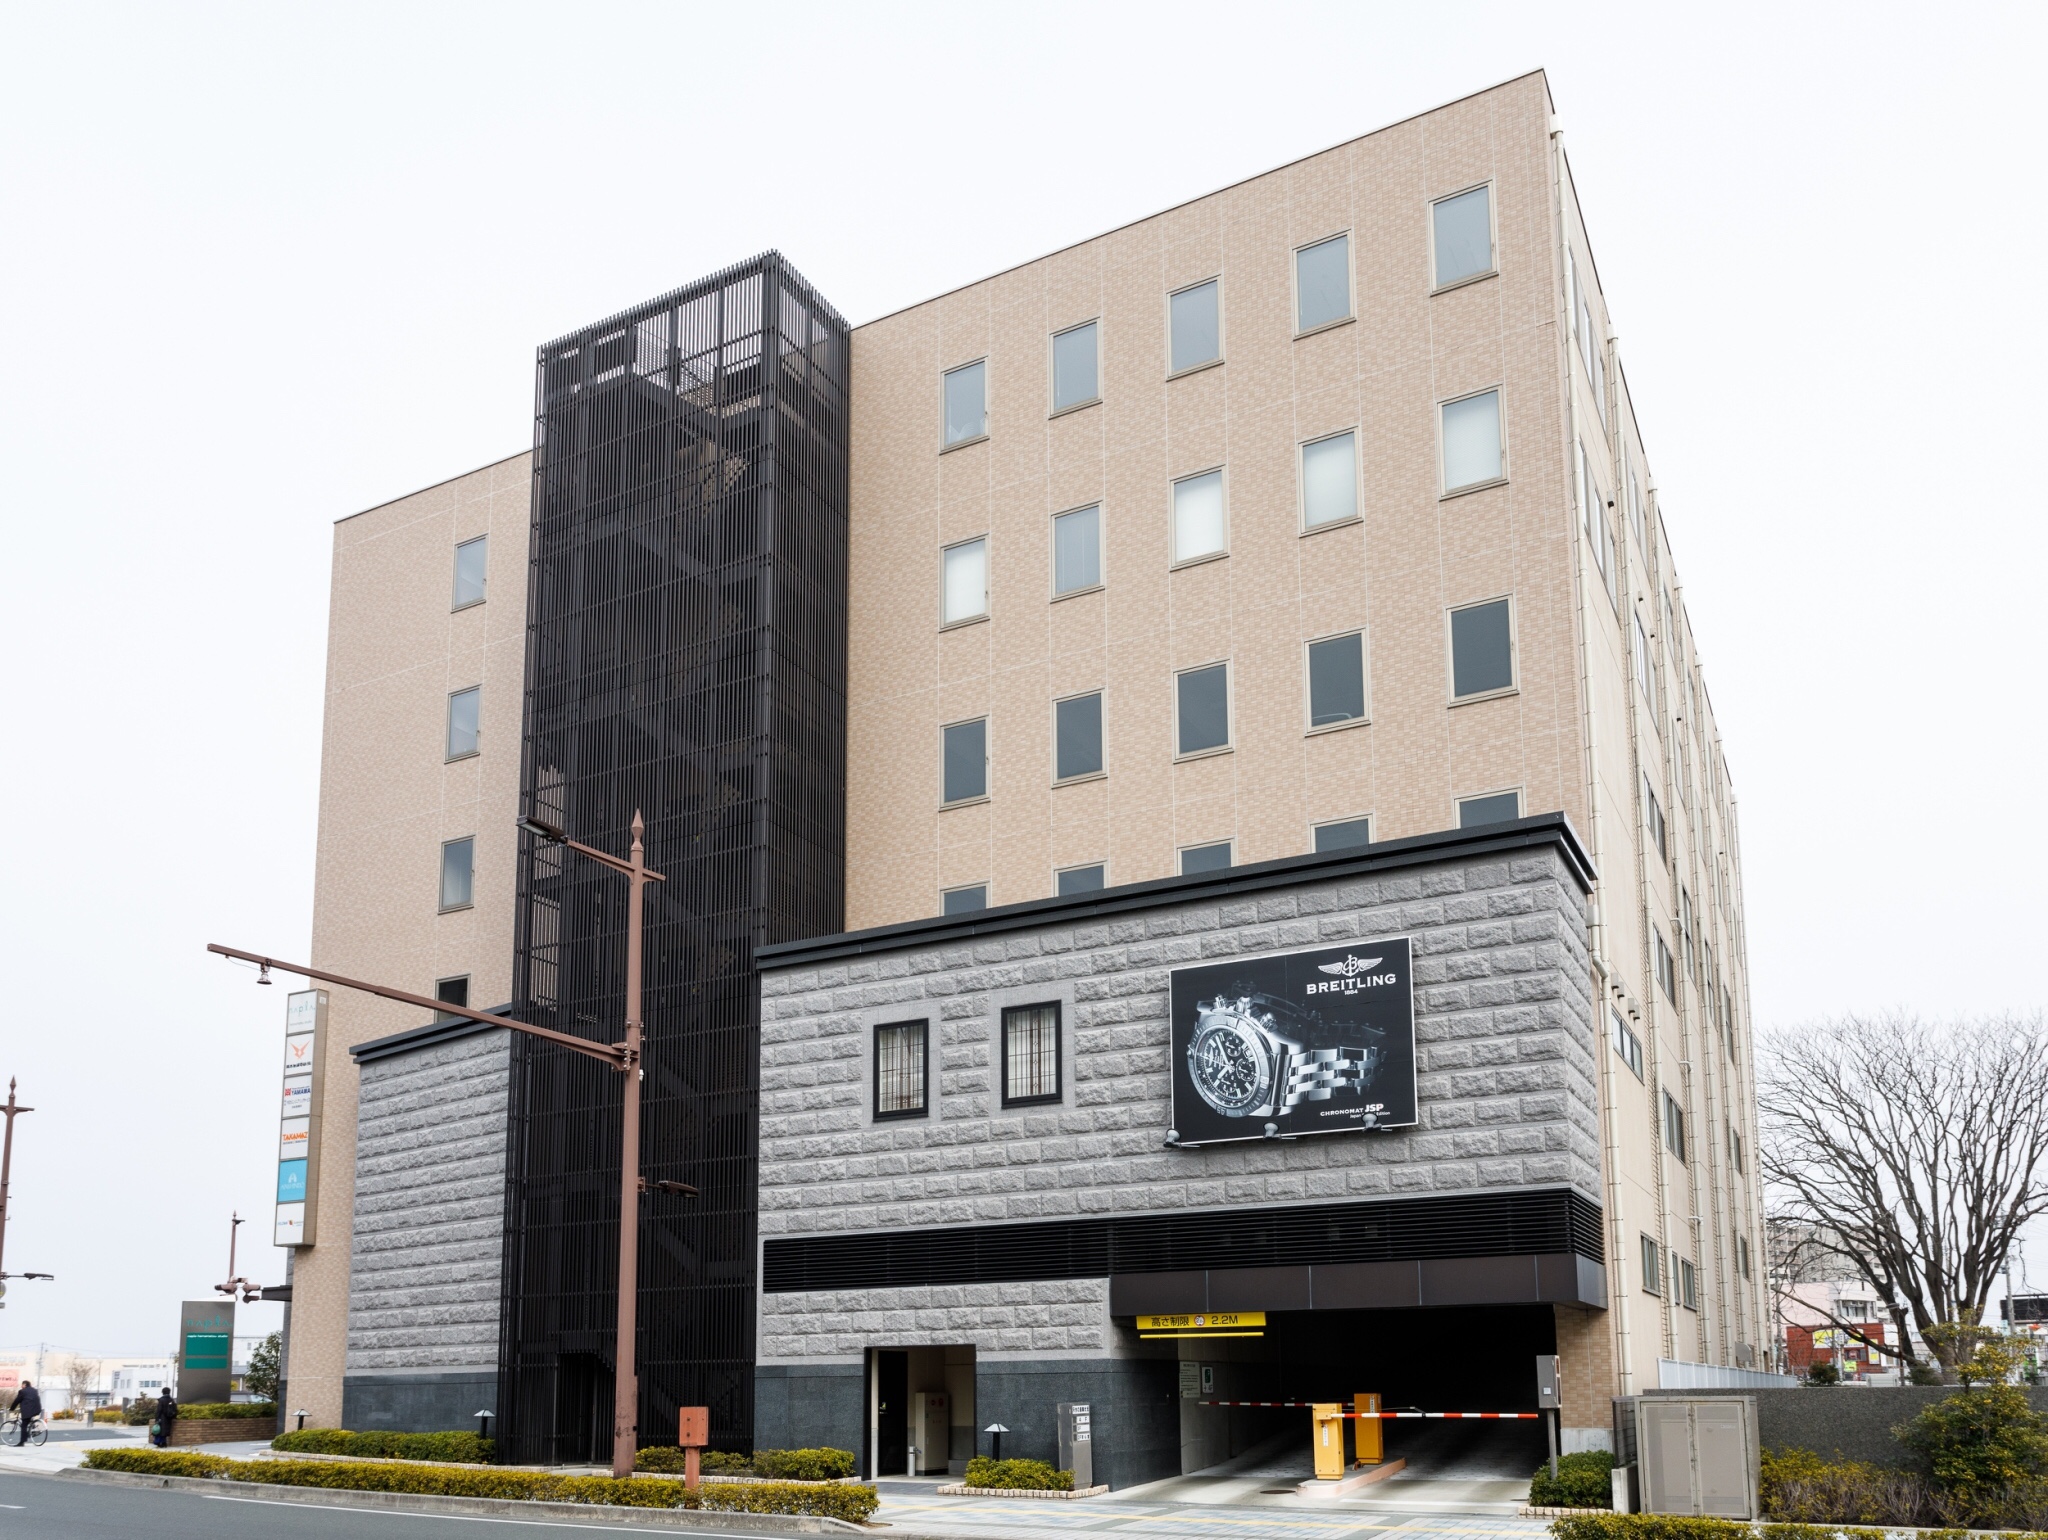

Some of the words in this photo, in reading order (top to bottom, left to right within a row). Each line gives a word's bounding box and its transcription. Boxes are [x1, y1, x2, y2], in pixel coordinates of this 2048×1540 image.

[1306, 973, 1396, 994] BREITLING
[1320, 1108, 1364, 1116] CHRONOMAT
[1364, 1103, 1384, 1112] JSP
[1151, 1316, 1189, 1327] 高さ制限
[1211, 1315, 1238, 1325] 2.2M
